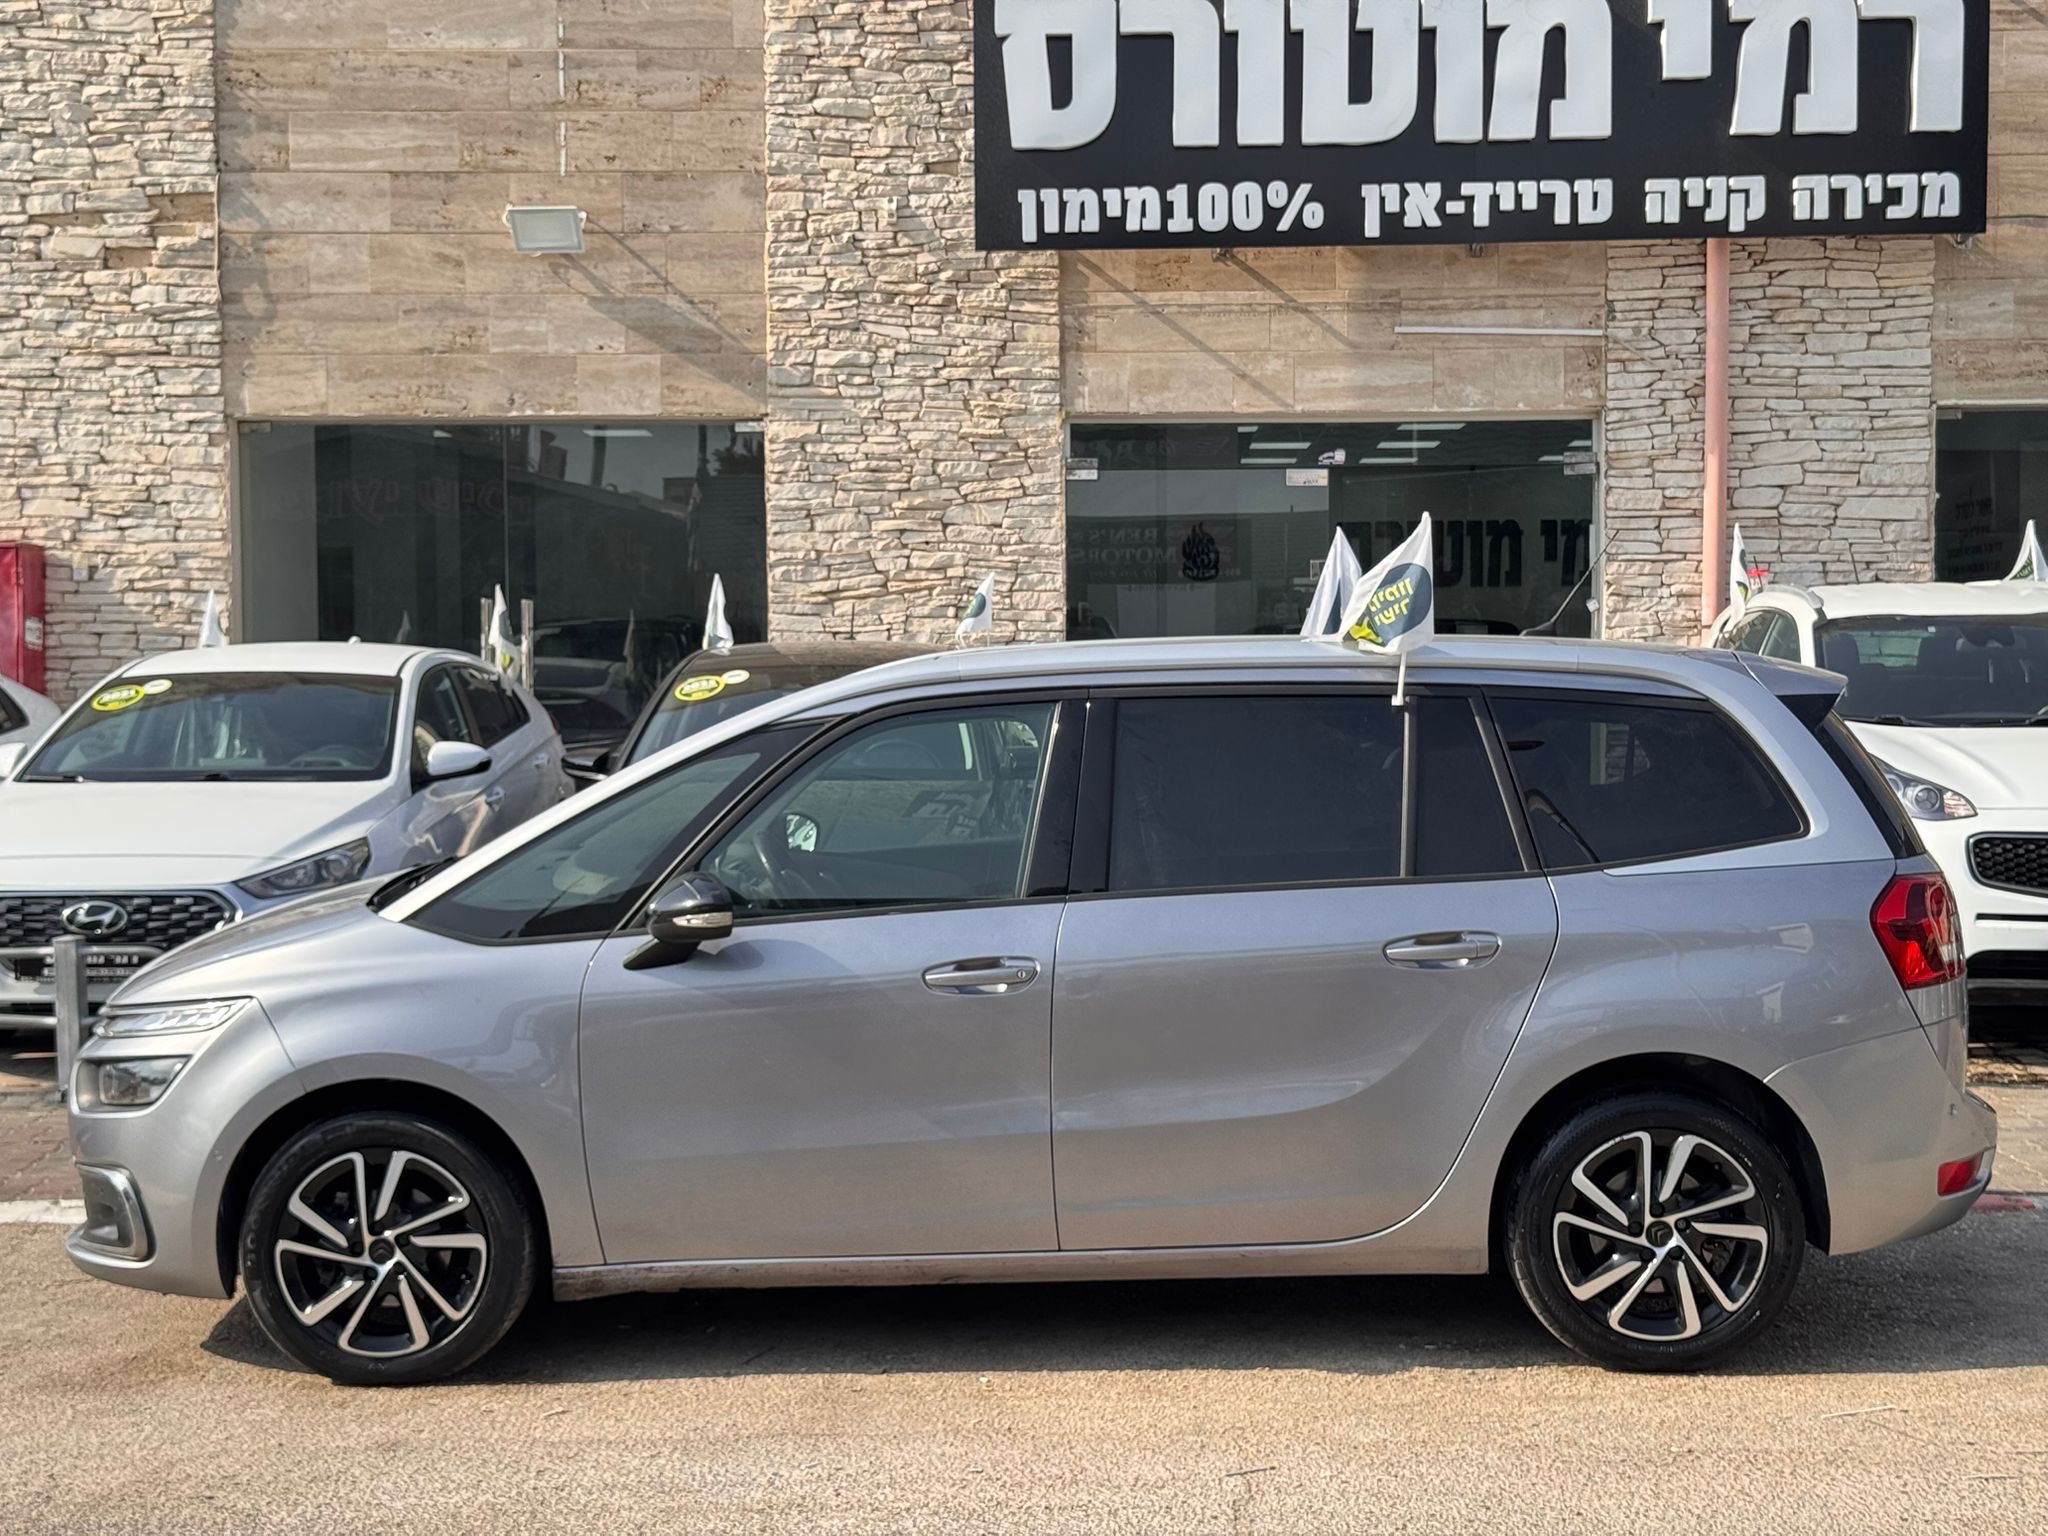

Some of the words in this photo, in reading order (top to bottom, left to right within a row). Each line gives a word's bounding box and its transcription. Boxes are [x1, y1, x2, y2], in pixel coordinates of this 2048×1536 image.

[994, 0, 1612, 150] מוטורס
[1647, 0, 1966, 135] רמי
[1360, 177, 1614, 238] טרייד-אין
[1644, 174, 1767, 233] קניה
[1792, 171, 1961, 221] מכירה
